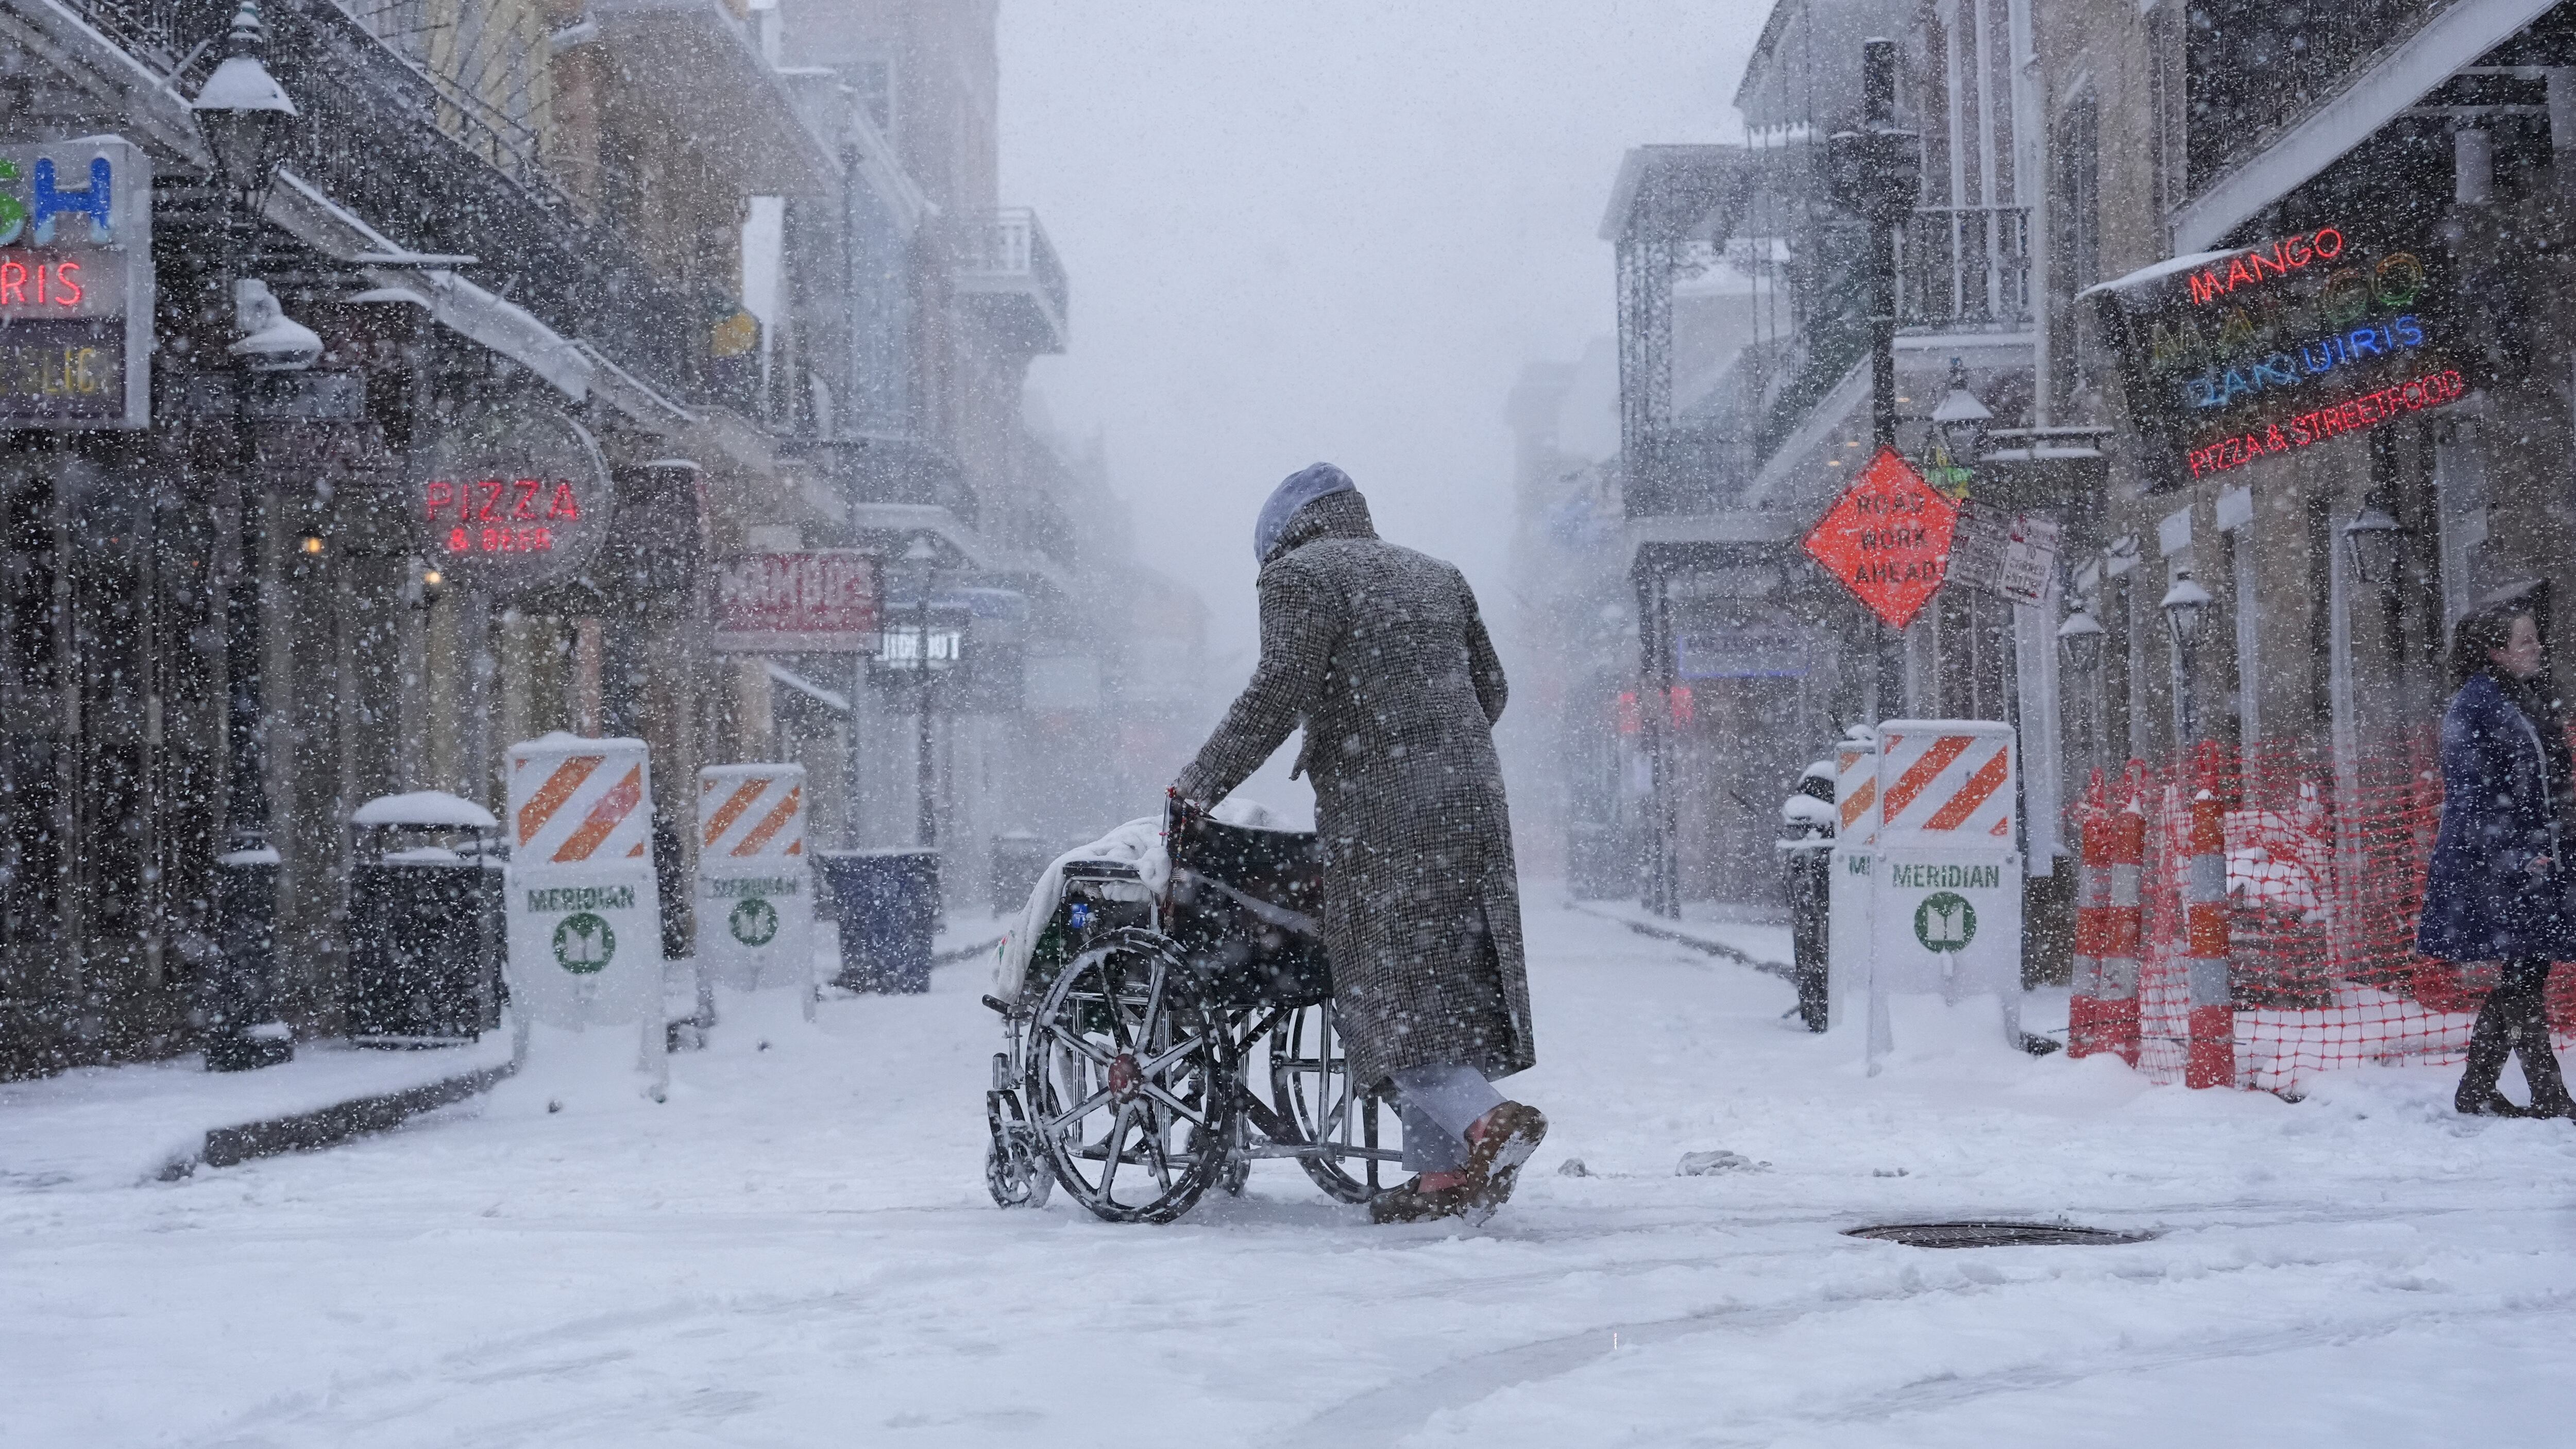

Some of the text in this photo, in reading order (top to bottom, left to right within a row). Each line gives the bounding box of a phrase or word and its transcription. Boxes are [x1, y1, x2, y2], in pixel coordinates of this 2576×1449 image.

[2190, 228, 2343, 305] MANGO
[1, 261, 82, 305] RIS
[2190, 434, 2264, 478] PIZZA
[2267, 424, 2288, 451] &
[428, 480, 577, 521] PIZZA
[449, 528, 468, 551] &
[1860, 529, 1928, 550] WORK
[1855, 561, 1936, 584] AHEAD
[1892, 864, 1999, 888] MERIDIAN
[528, 885, 635, 912] MERIDIAN
